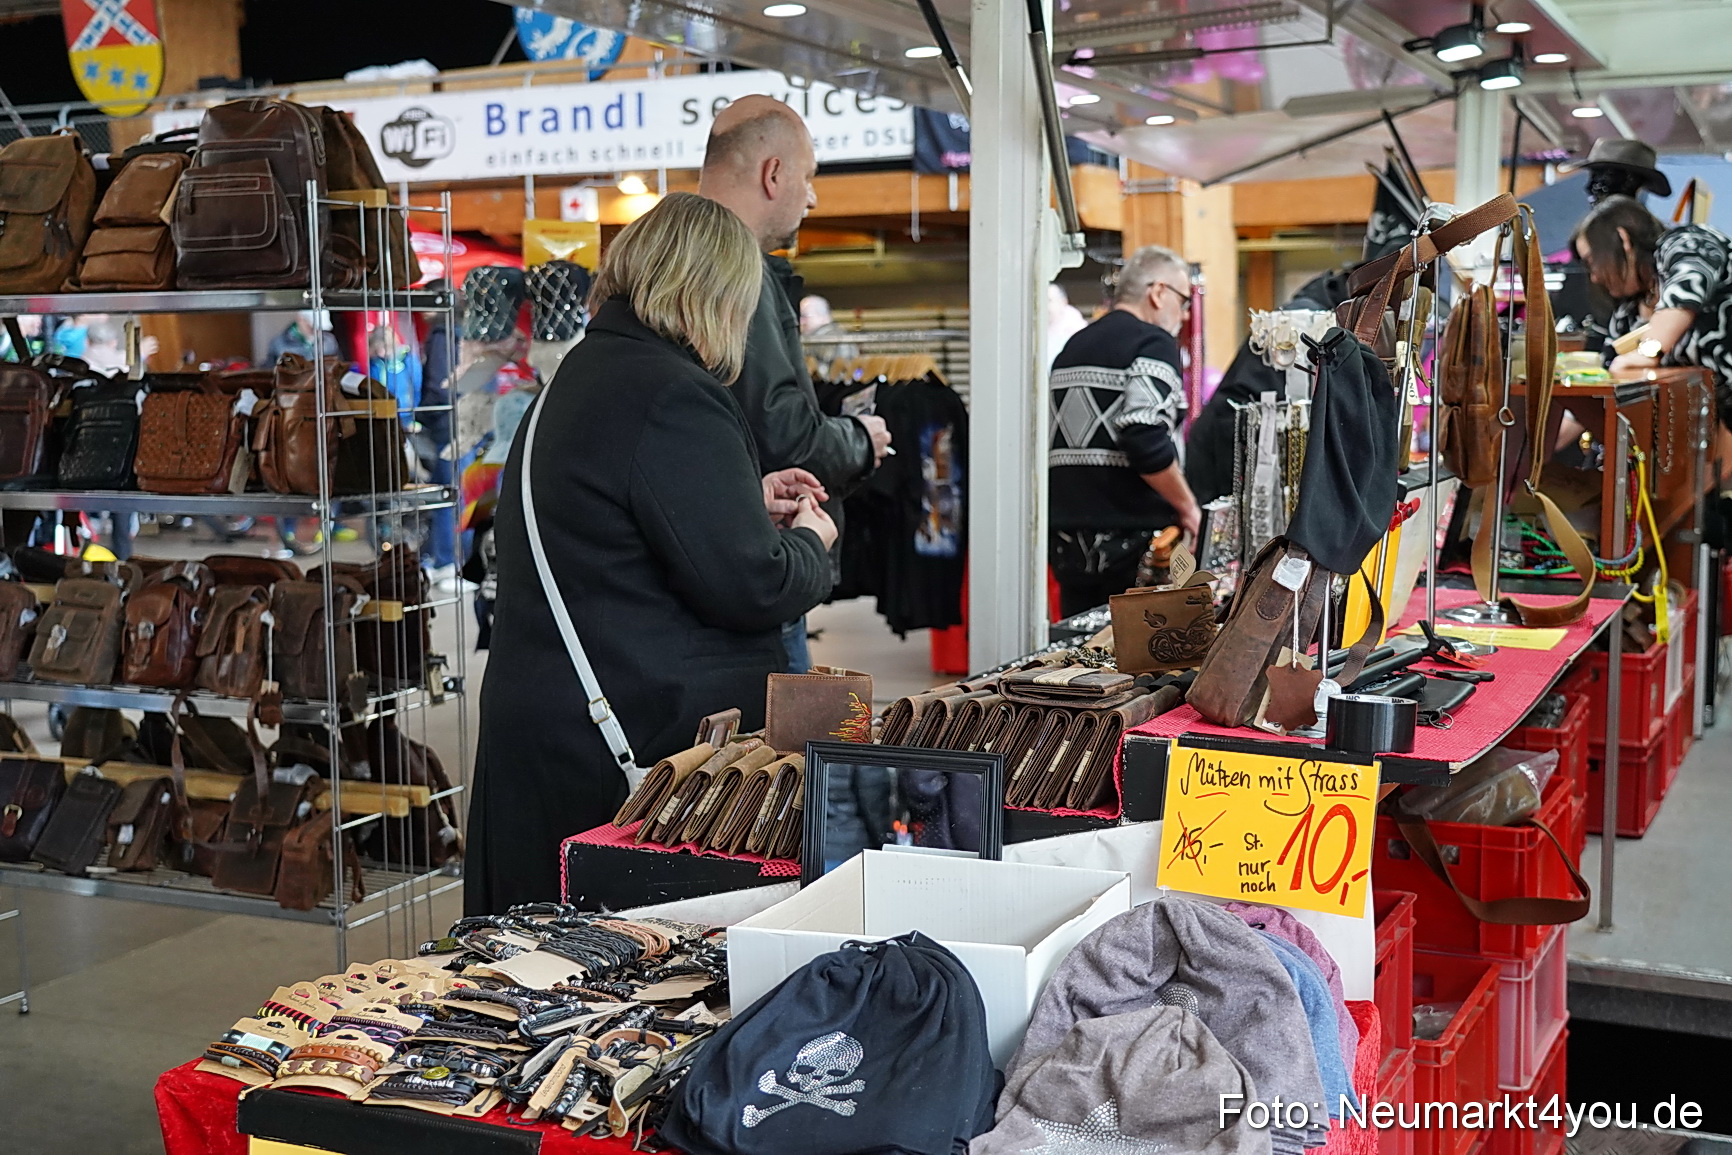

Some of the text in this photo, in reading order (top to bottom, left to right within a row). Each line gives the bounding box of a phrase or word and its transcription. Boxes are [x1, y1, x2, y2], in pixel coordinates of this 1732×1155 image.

[486, 89, 907, 137] Brandl seice
[486, 144, 580, 166] einfach
[590, 139, 686, 162] schnell
[1180, 752, 1250, 795] Mützen
[1259, 767, 1294, 790] mit
[1243, 832, 1264, 851] St.
[1238, 860, 1271, 877] nur
[1240, 872, 1276, 893] noch
